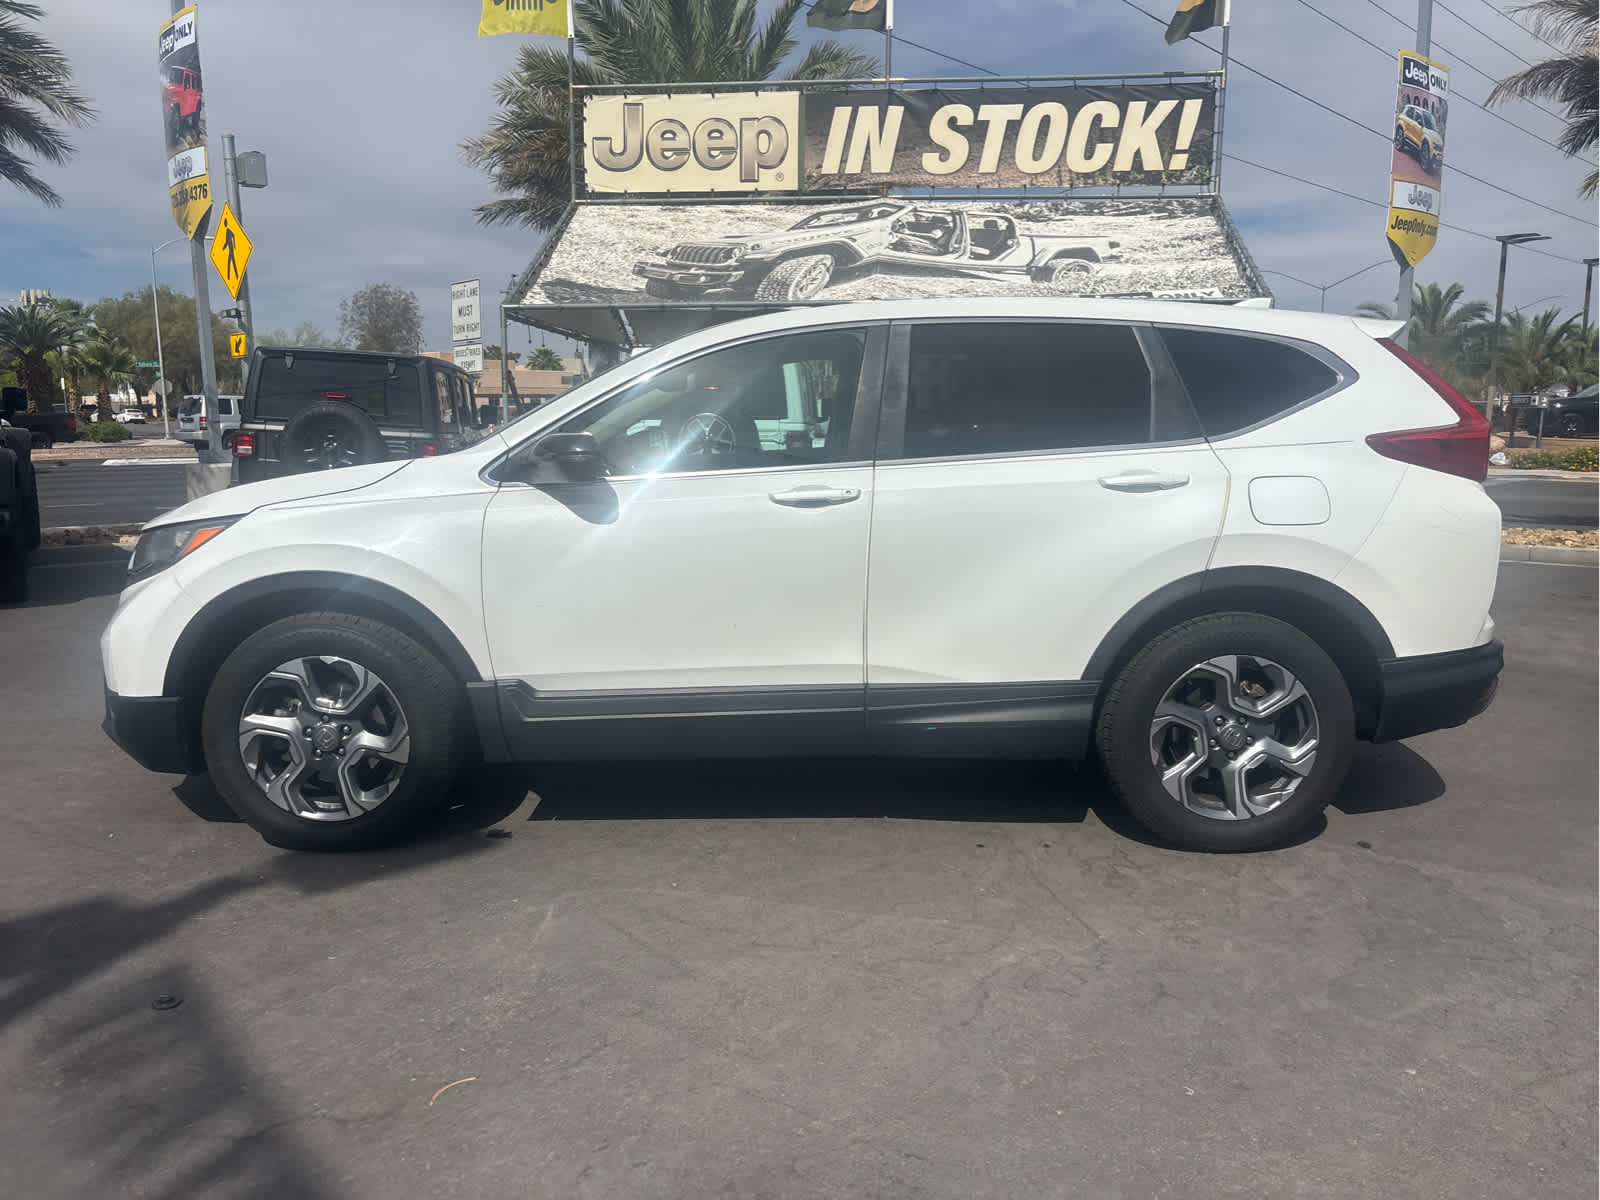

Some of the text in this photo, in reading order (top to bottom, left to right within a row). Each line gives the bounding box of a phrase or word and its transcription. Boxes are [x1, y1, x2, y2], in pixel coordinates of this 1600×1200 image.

[174, 21, 193, 42] ONLY
[1405, 61, 1448, 92] Jeep ONLY
[592, 103, 789, 183] Jeep
[820, 98, 1203, 175] IN STOCK!
[1408, 184, 1433, 212] Jeep
[1391, 215, 1438, 237] JeepOnly.com
[466, 287, 479, 298] LANE
[458, 305, 473, 317] MUST
